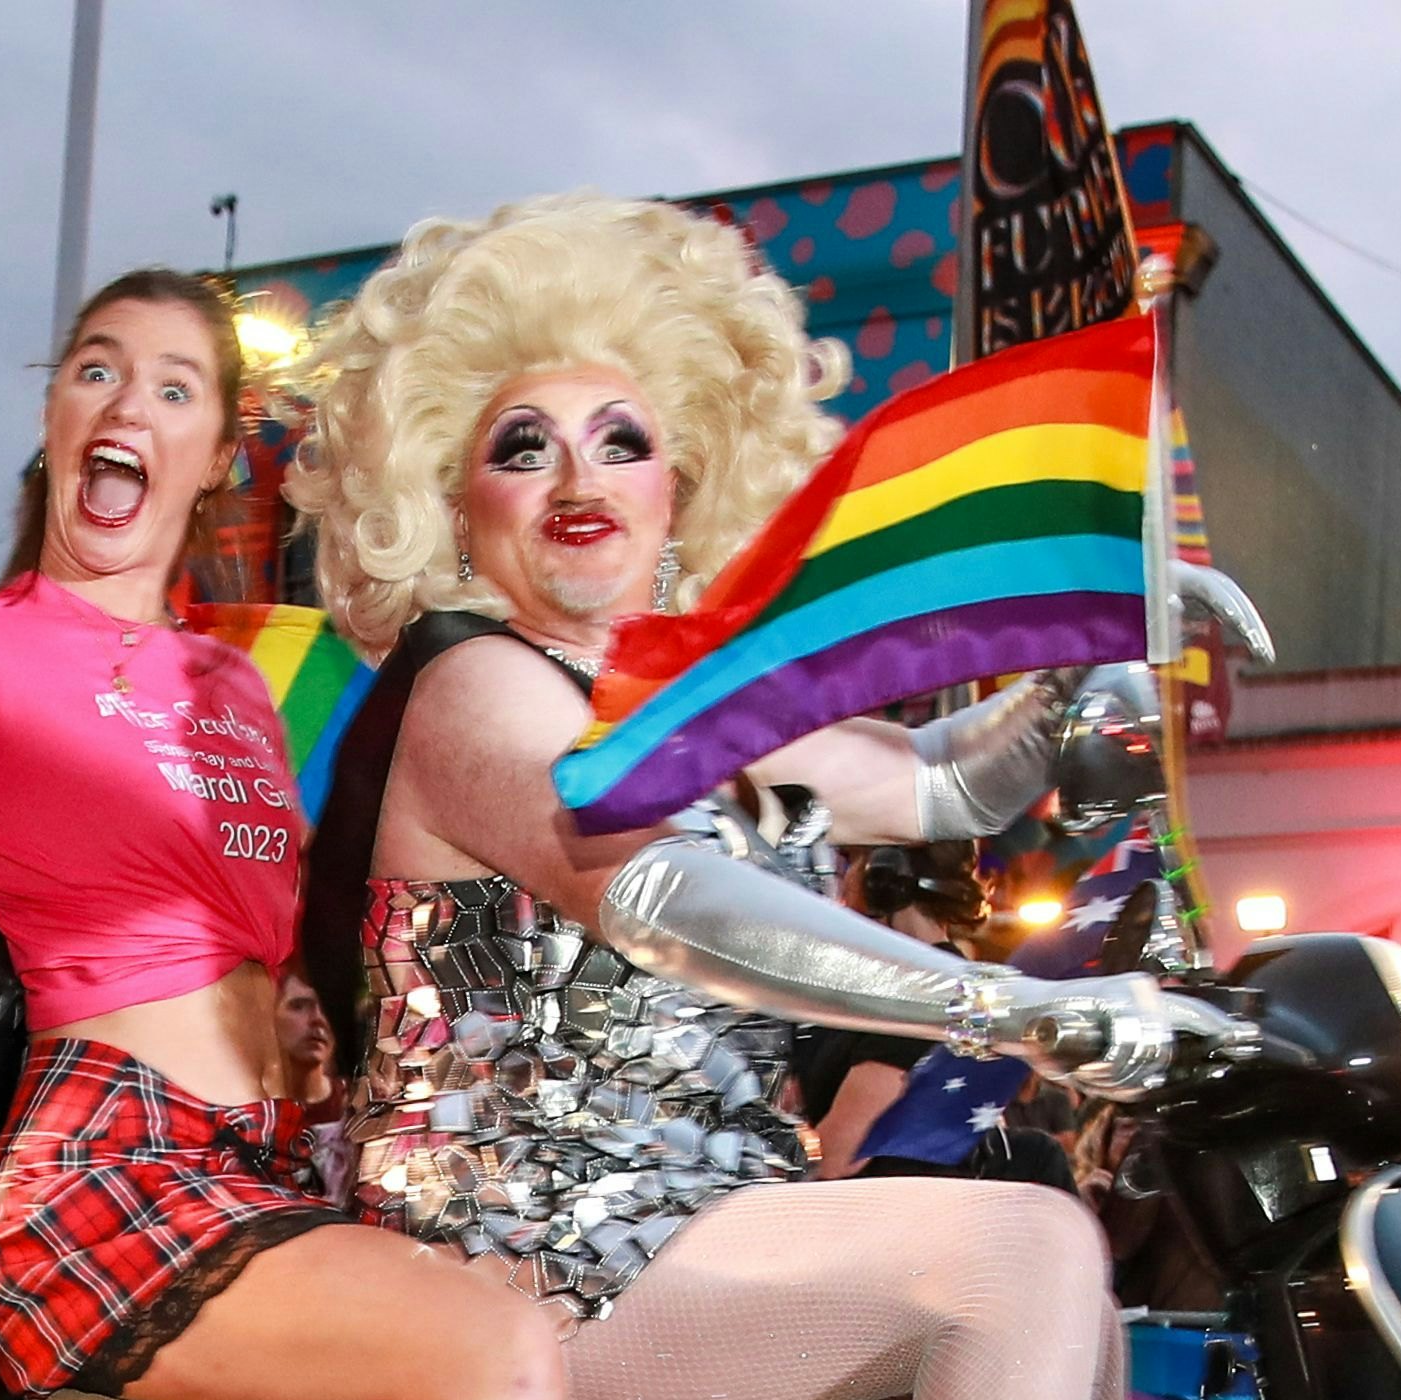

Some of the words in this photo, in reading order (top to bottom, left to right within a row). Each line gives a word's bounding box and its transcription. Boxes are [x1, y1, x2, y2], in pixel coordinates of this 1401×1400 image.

[194, 751, 226, 770] Gay
[229, 755, 254, 769] and
[156, 761, 248, 805] Mardi
[219, 821, 289, 864] 2023
